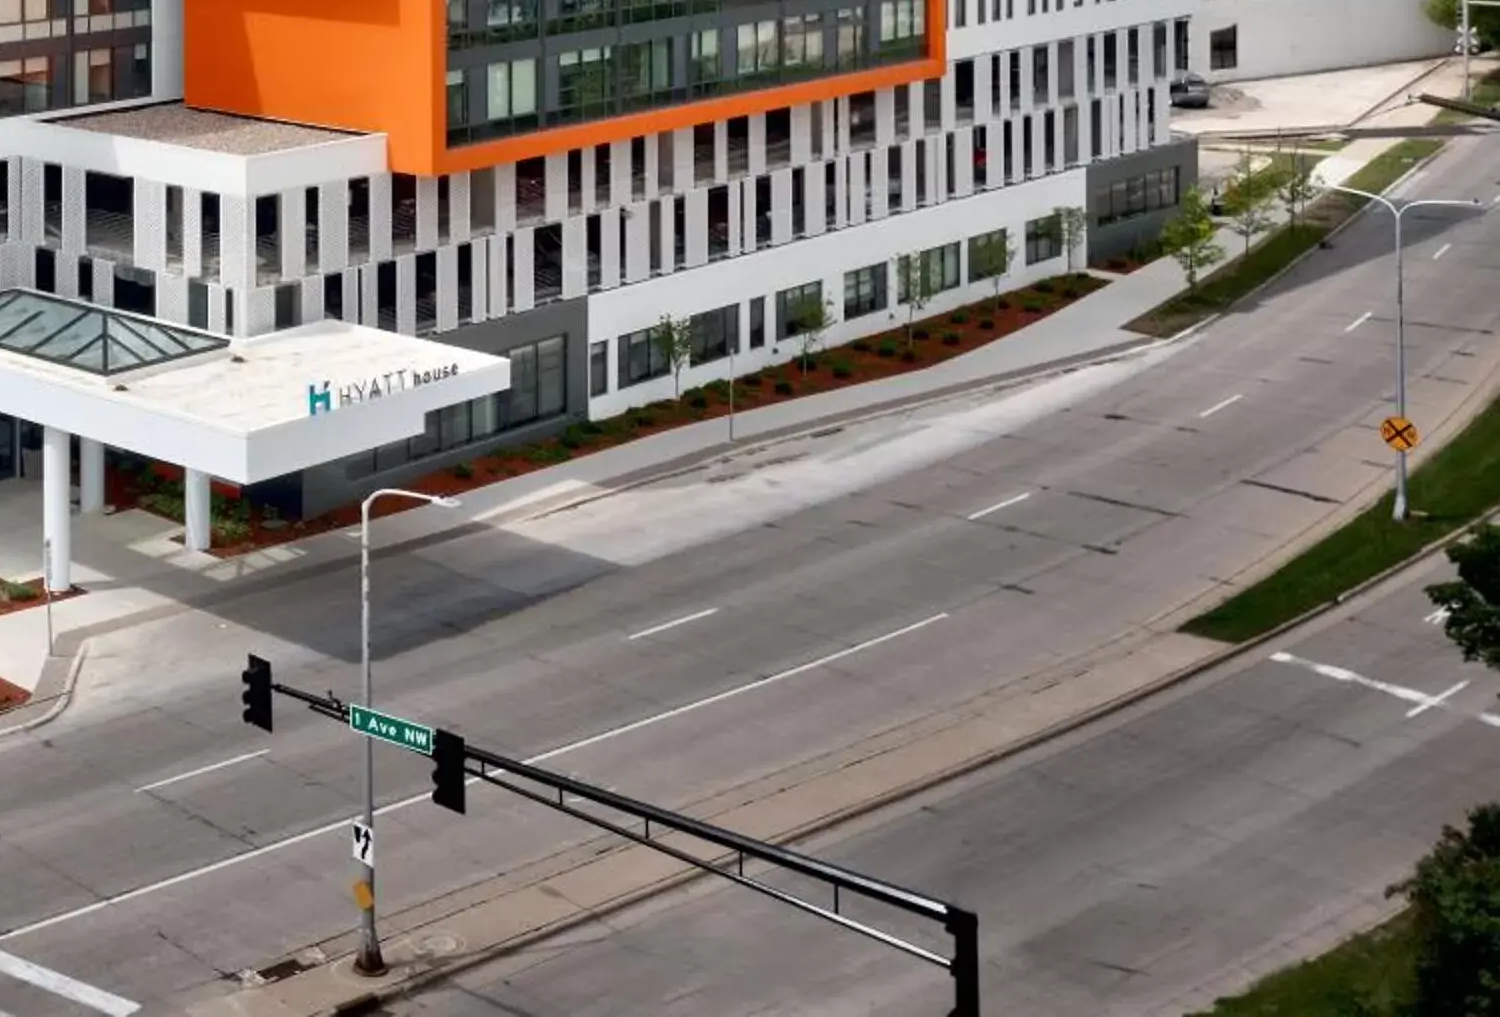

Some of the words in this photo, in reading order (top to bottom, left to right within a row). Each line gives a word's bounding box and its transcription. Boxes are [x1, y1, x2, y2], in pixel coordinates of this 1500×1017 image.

[339, 369, 406, 407] HYATT
[414, 363, 458, 386] house
[369, 717, 397, 737] Ave
[405, 727, 428, 747] NW
